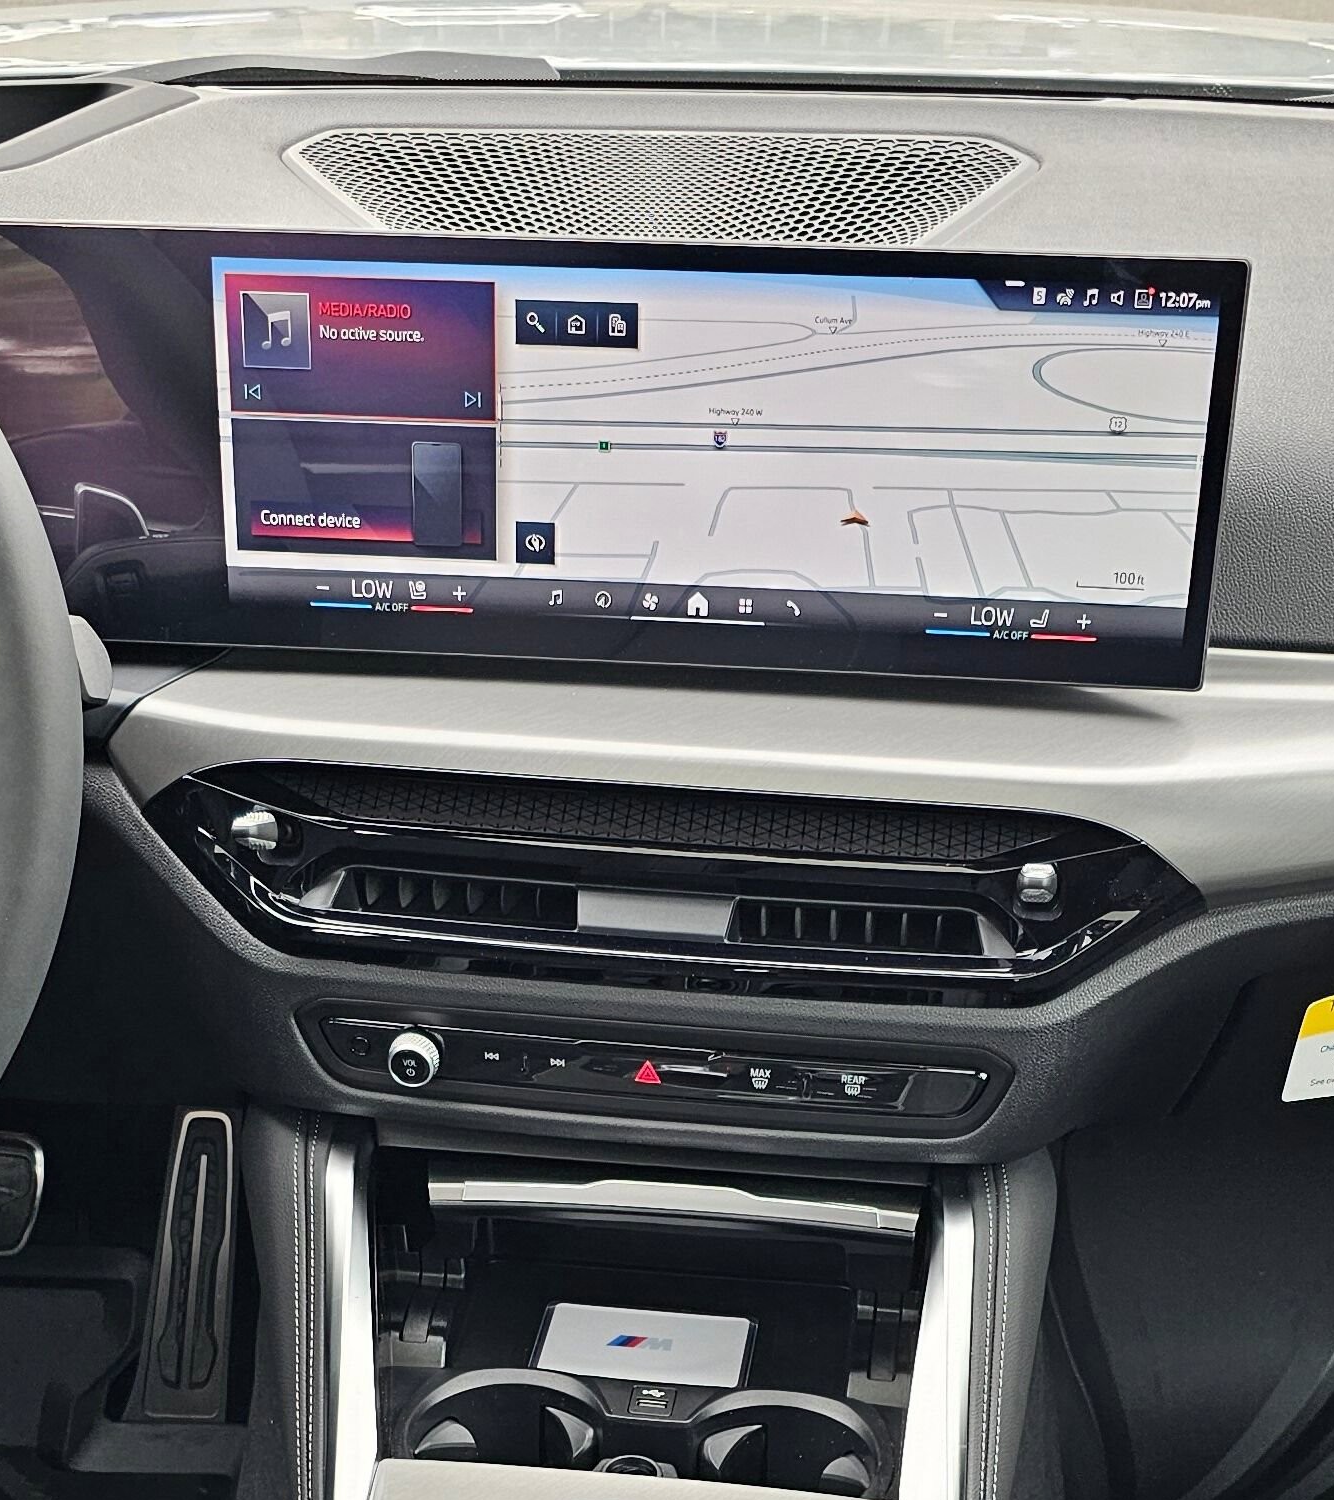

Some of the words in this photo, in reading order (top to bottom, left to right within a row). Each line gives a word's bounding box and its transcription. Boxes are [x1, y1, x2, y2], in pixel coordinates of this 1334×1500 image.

[1158, 291, 1211, 309] 12:07pm
[318, 301, 411, 319] MEDIA/RADIO
[319, 324, 338, 340] No
[340, 326, 377, 341] active
[379, 329, 425, 343] source.
[708, 407, 740, 417] Highway
[1114, 420, 1123, 428] 12
[260, 509, 315, 527] Connect
[318, 512, 361, 529] device
[1113, 571, 1135, 585] 100
[351, 579, 393, 599] LOW
[375, 602, 390, 612] A/C
[391, 602, 409, 613] OFF
[970, 605, 1015, 627] LOW
[993, 629, 1010, 640] A/C
[1010, 630, 1029, 641] OFF
[402, 1059, 417, 1067] VOL
[750, 1067, 771, 1079] MAX
[840, 1074, 866, 1085] REAR
